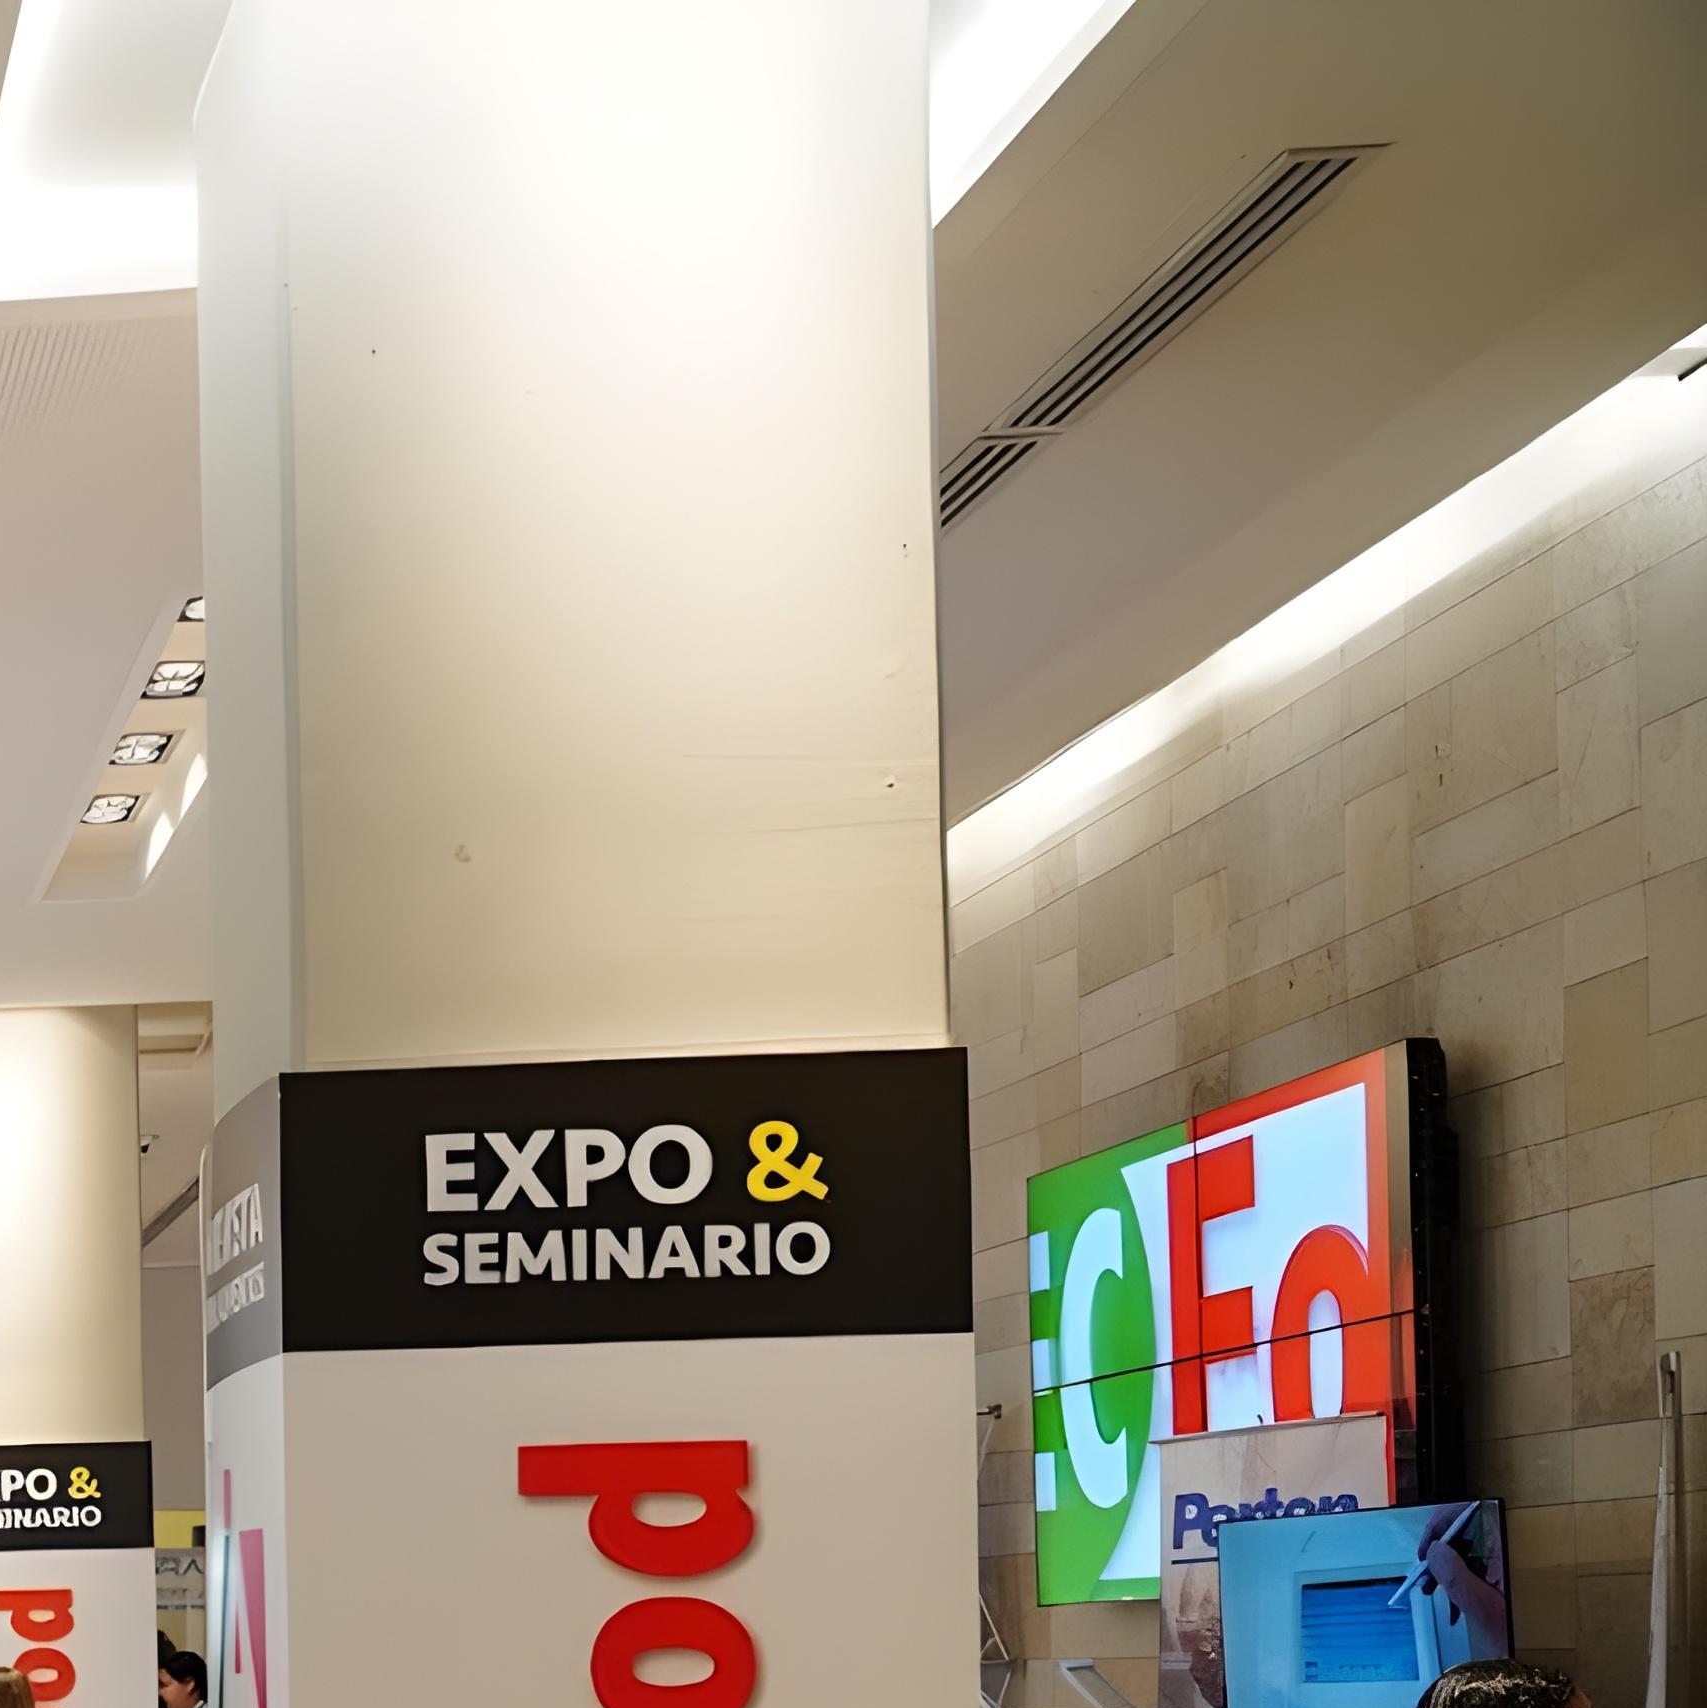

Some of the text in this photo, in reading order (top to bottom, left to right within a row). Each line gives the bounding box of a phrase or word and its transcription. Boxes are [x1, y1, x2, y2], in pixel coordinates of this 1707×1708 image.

[424, 1120, 829, 1213] EXPO &
[422, 1220, 831, 1287] SEMINARIO
[67, 1466, 102, 1500] &
